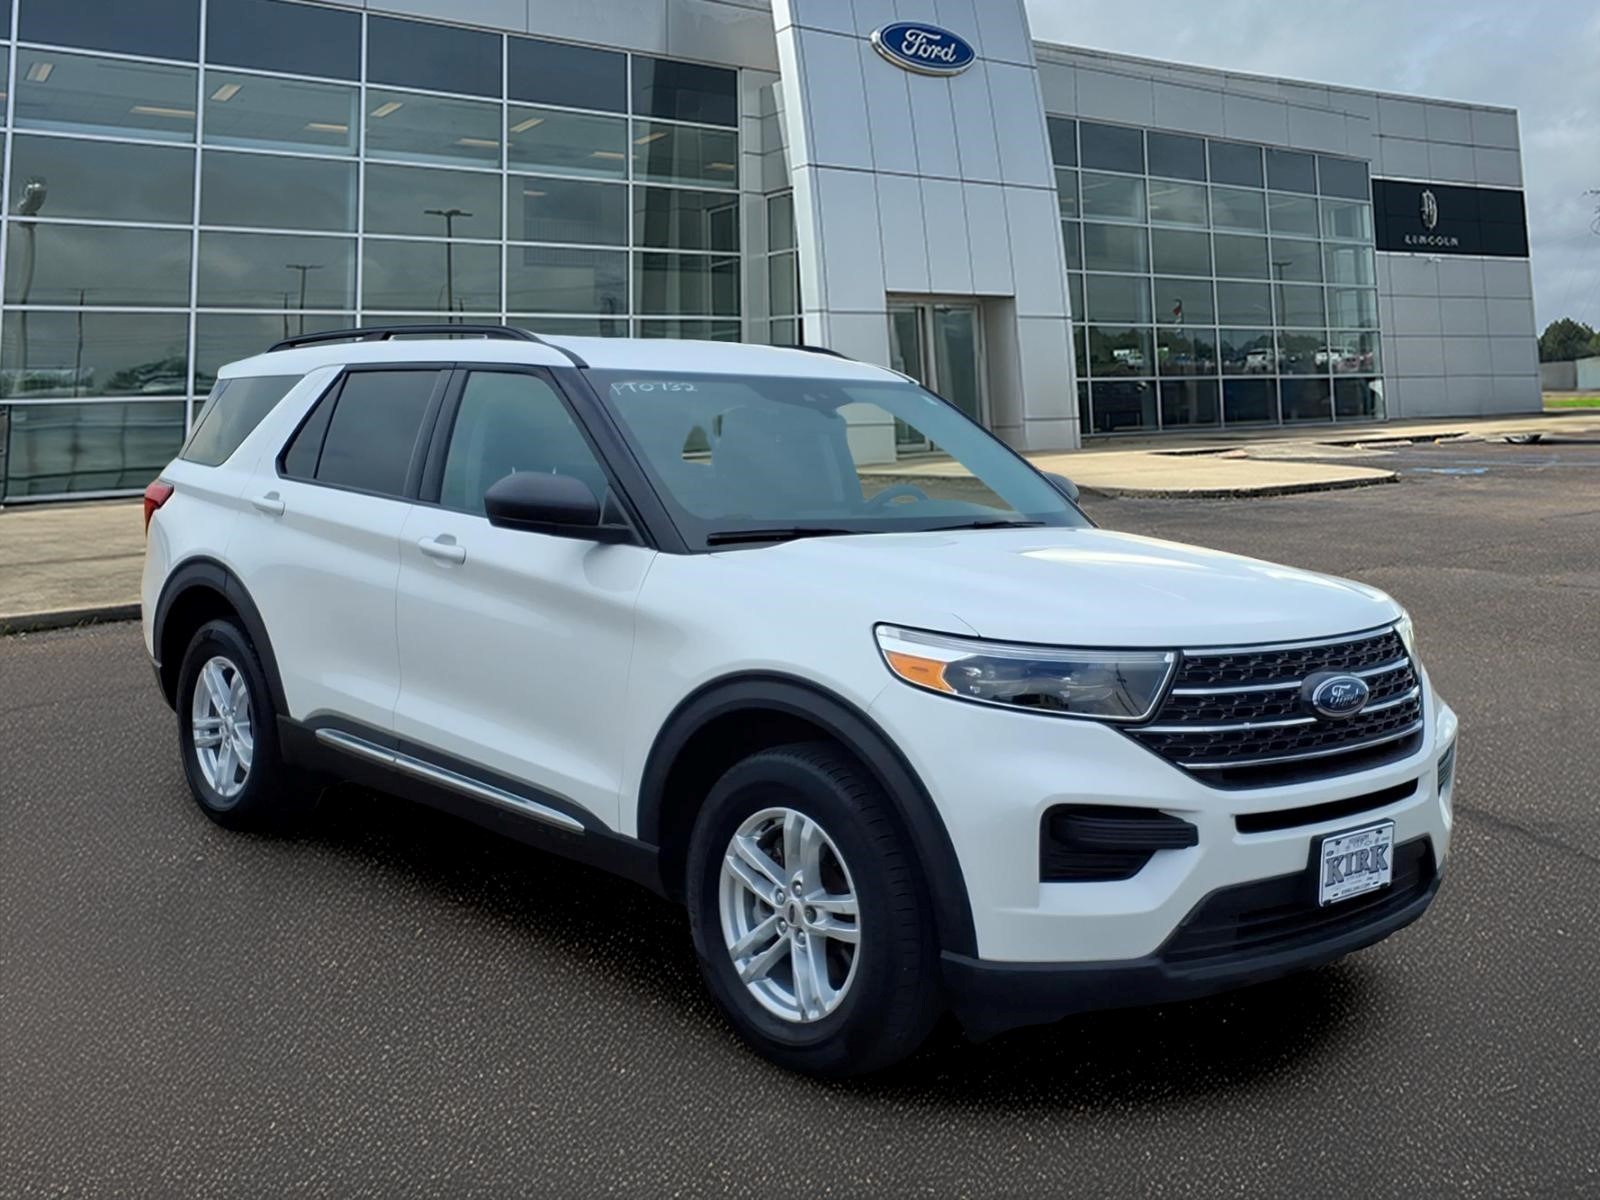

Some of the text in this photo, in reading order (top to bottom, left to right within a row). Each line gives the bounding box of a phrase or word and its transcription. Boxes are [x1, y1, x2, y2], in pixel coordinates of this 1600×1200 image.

[900, 28, 957, 62] Ford
[1405, 235, 1459, 247] LINCOLN
[1329, 684, 1360, 706] Ford
[1324, 842, 1390, 888] KIRK
